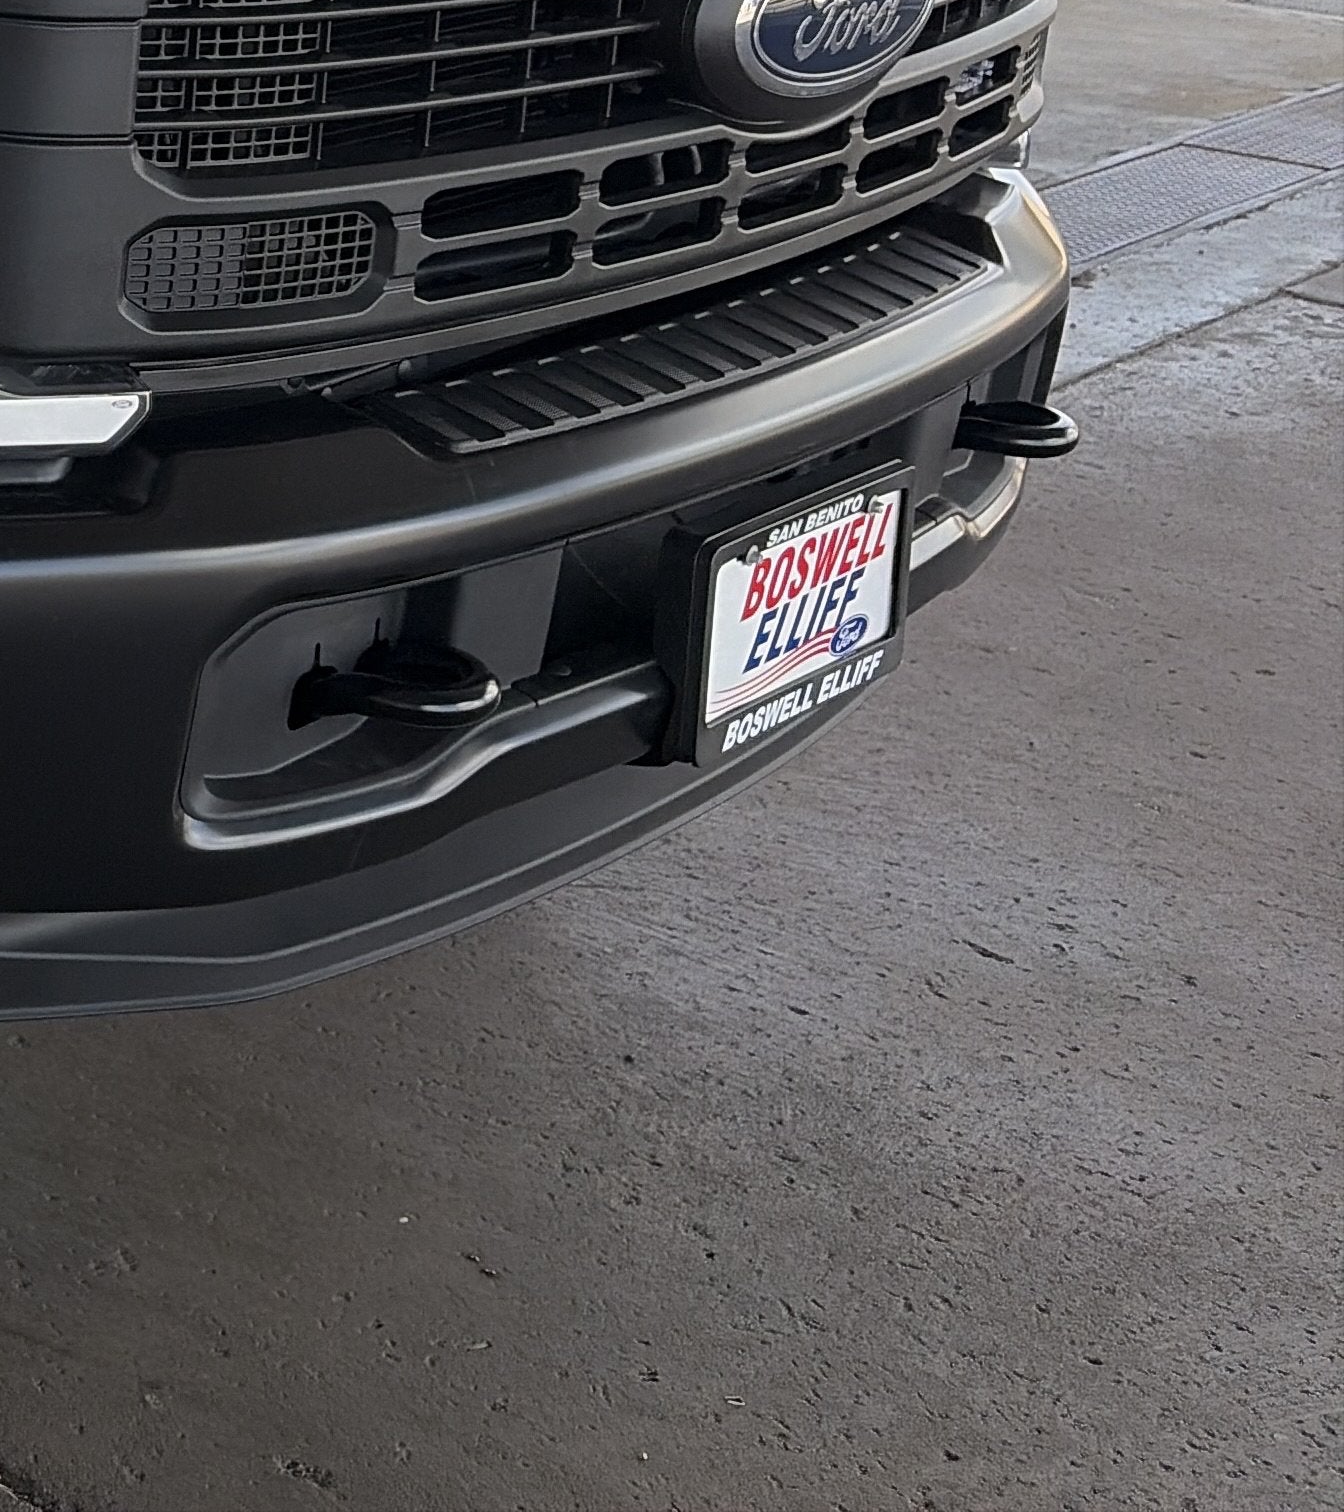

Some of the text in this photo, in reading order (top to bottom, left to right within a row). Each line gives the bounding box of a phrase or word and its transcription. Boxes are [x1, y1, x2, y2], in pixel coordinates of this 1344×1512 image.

[740, 502, 894, 623] BOSWELL
[766, 492, 865, 548] SAN BENITO
[741, 566, 866, 675] ELLIFF
[721, 649, 885, 754] BOSWELL ELLIFF
